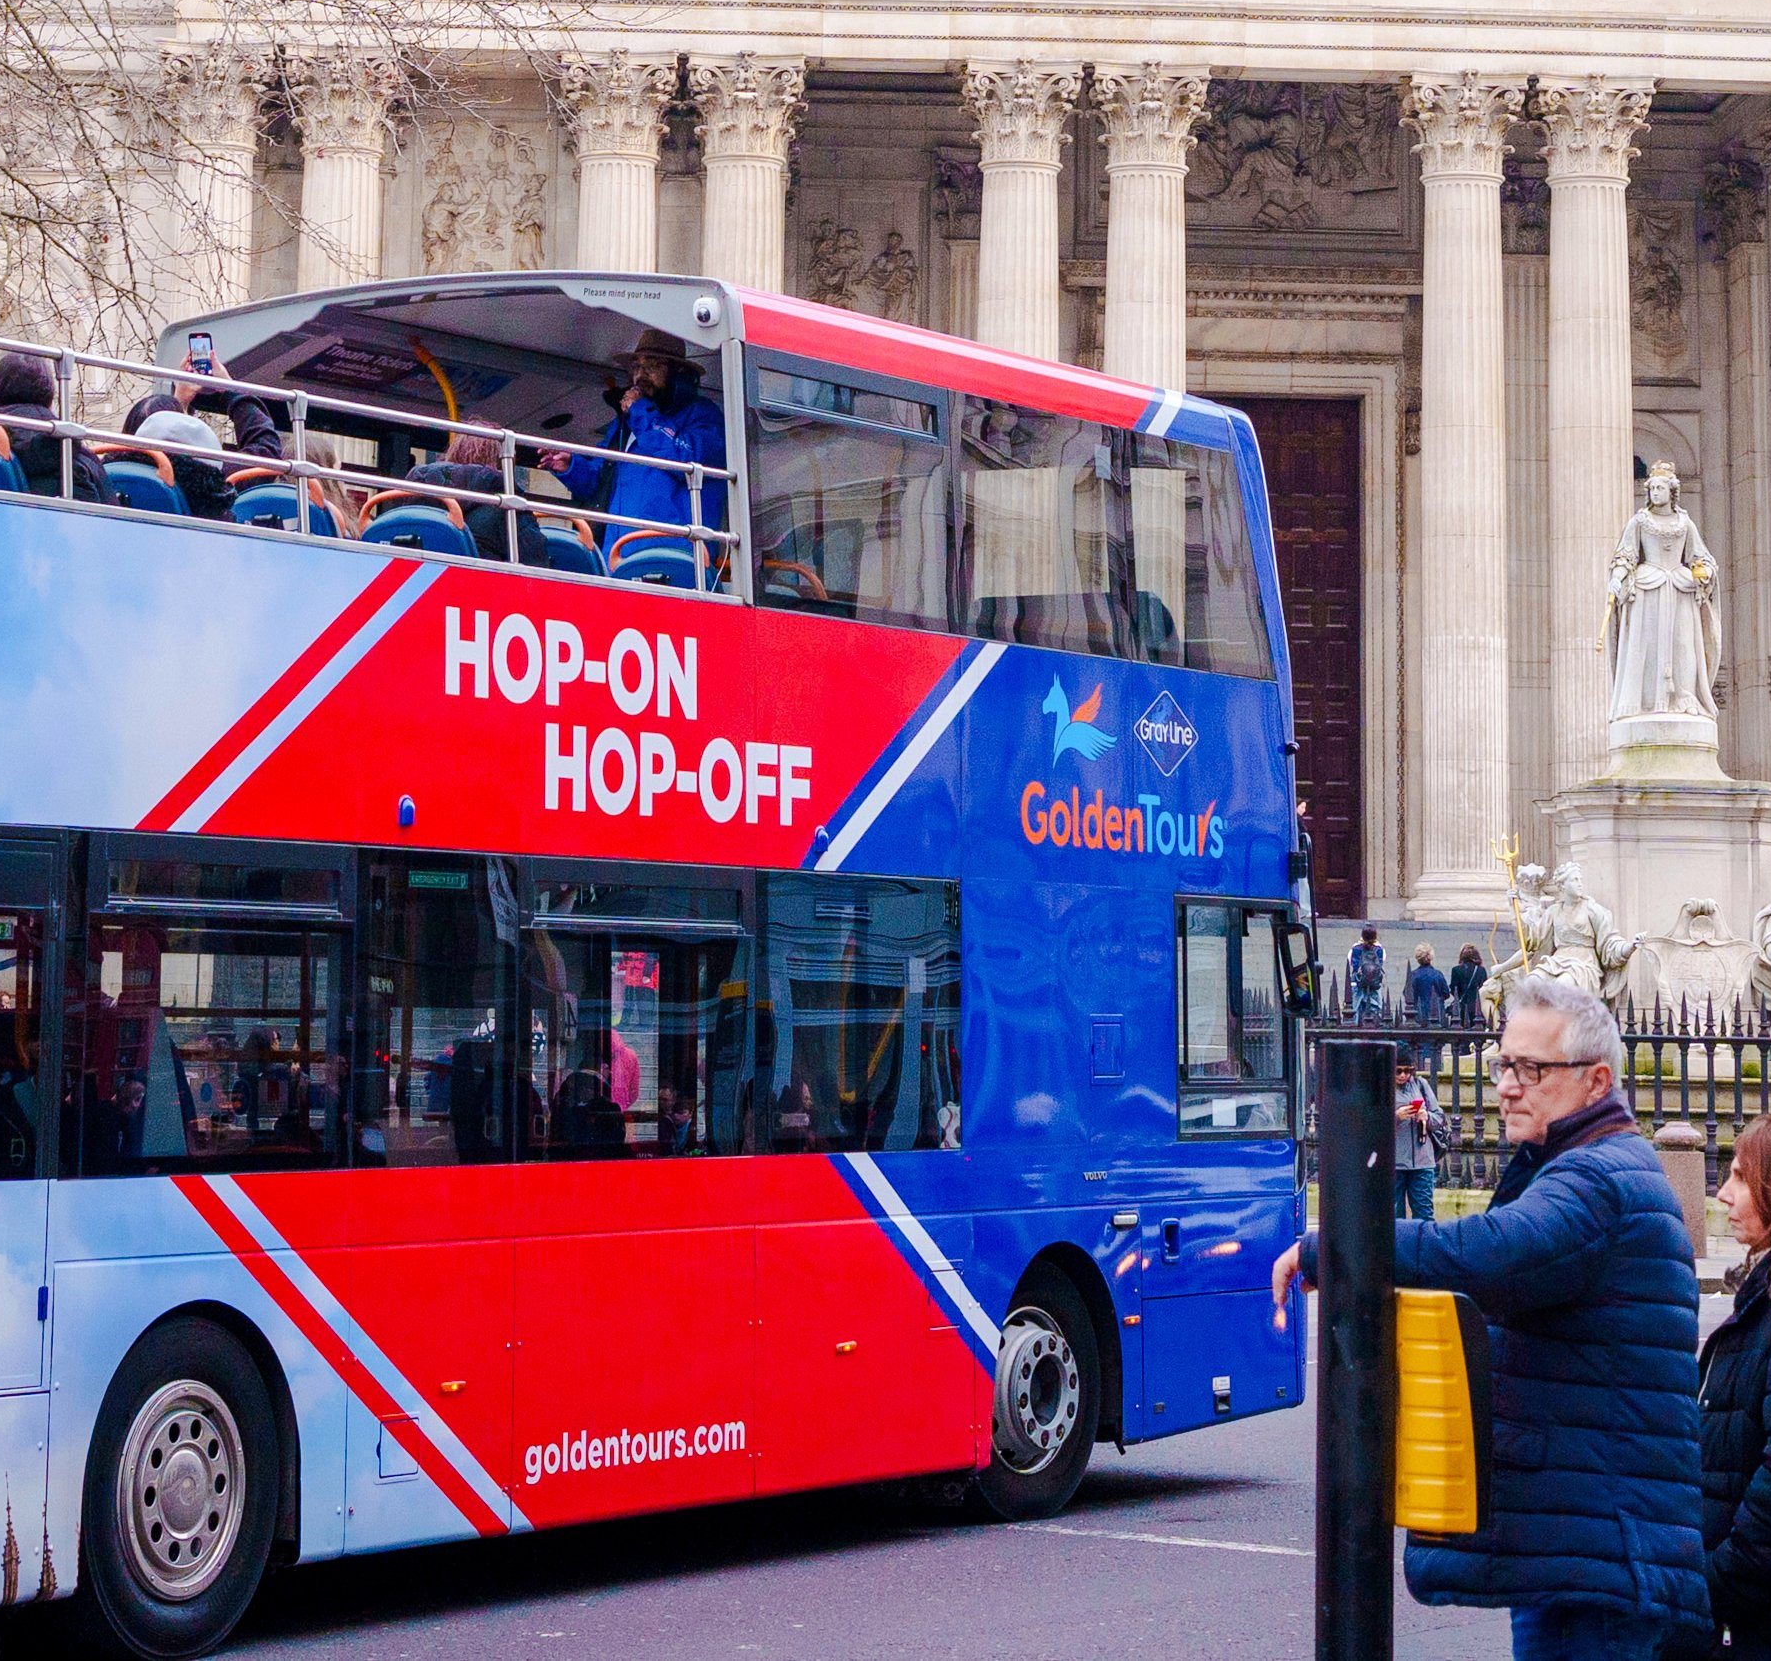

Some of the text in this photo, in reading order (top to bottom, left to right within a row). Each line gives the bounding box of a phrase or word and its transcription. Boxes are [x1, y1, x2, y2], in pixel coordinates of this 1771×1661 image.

[583, 287, 661, 300] Please mind your head
[444, 605, 698, 720] HOP-ON
[544, 722, 813, 827] HOP-OFF
[1021, 781, 1224, 859] GoldenTours
[1083, 1171, 1107, 1181] VOLVO
[525, 1421, 745, 1483] goldentours.com
